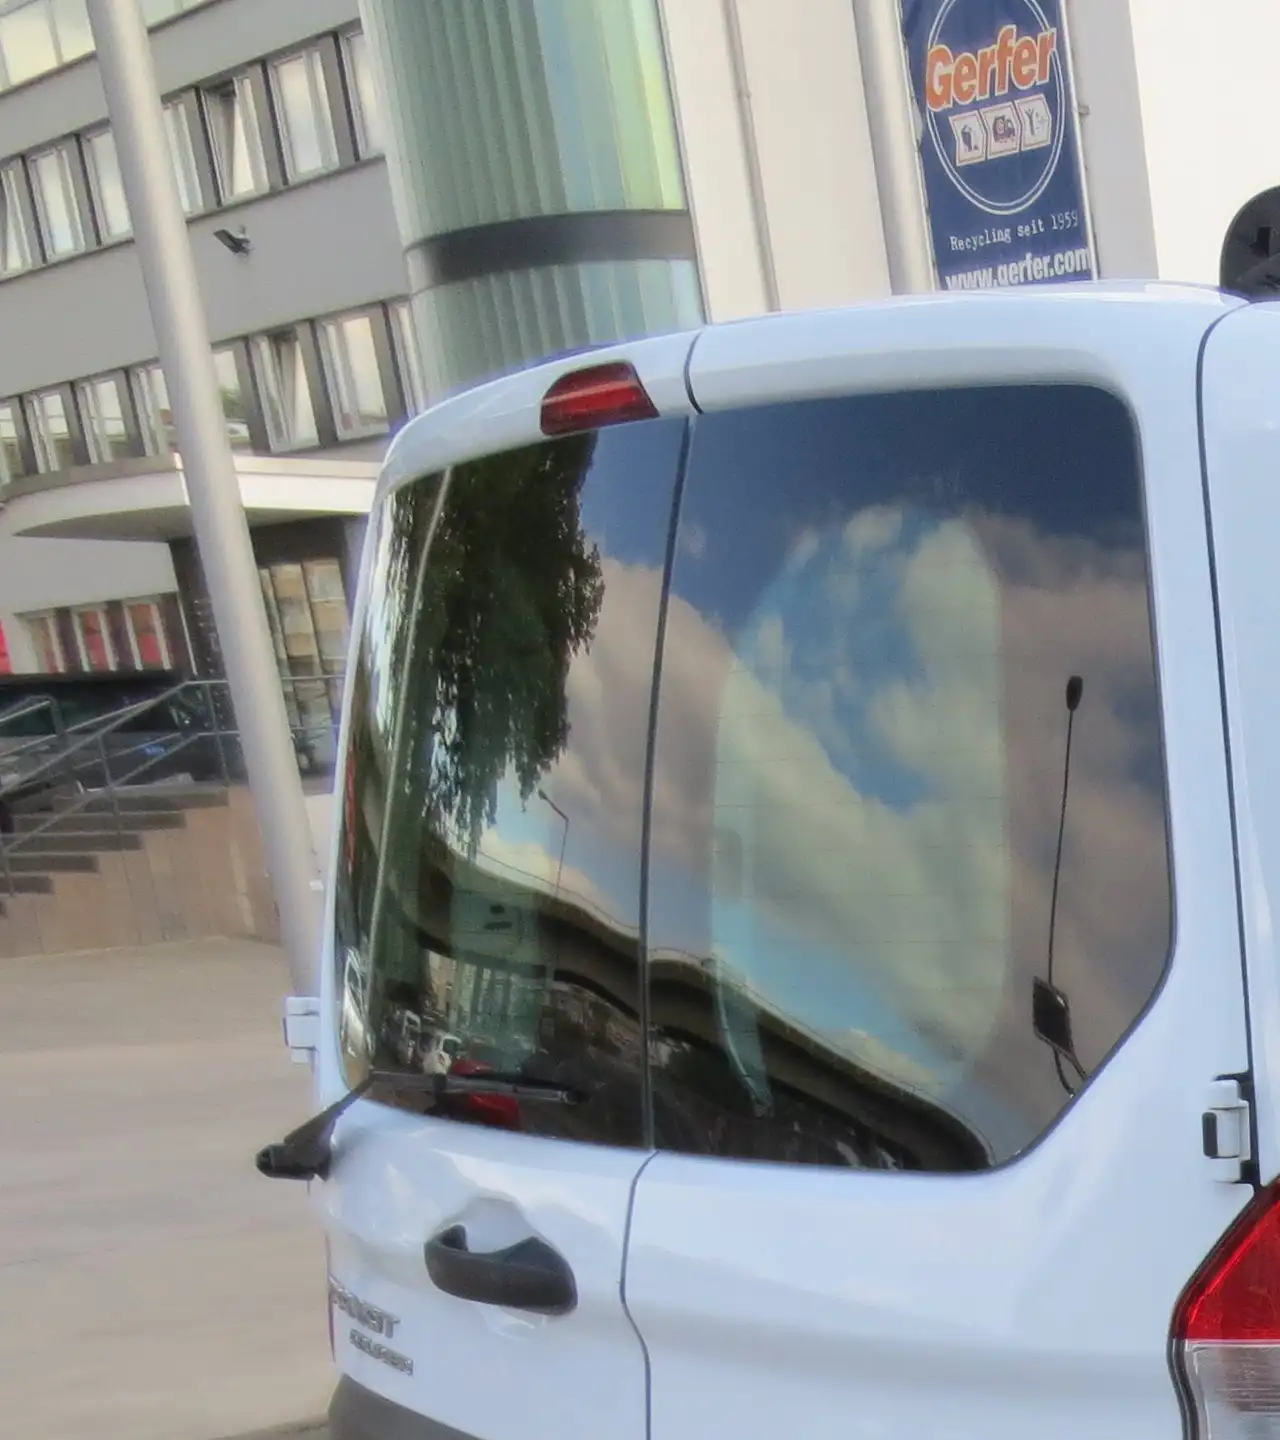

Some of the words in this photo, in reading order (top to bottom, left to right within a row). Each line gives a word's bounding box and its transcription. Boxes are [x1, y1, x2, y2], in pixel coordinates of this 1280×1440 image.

[926, 24, 1057, 112] Gerfer
[950, 230, 1012, 251] Recycling
[1017, 219, 1044, 237] seit
[1051, 211, 1078, 230] 1959
